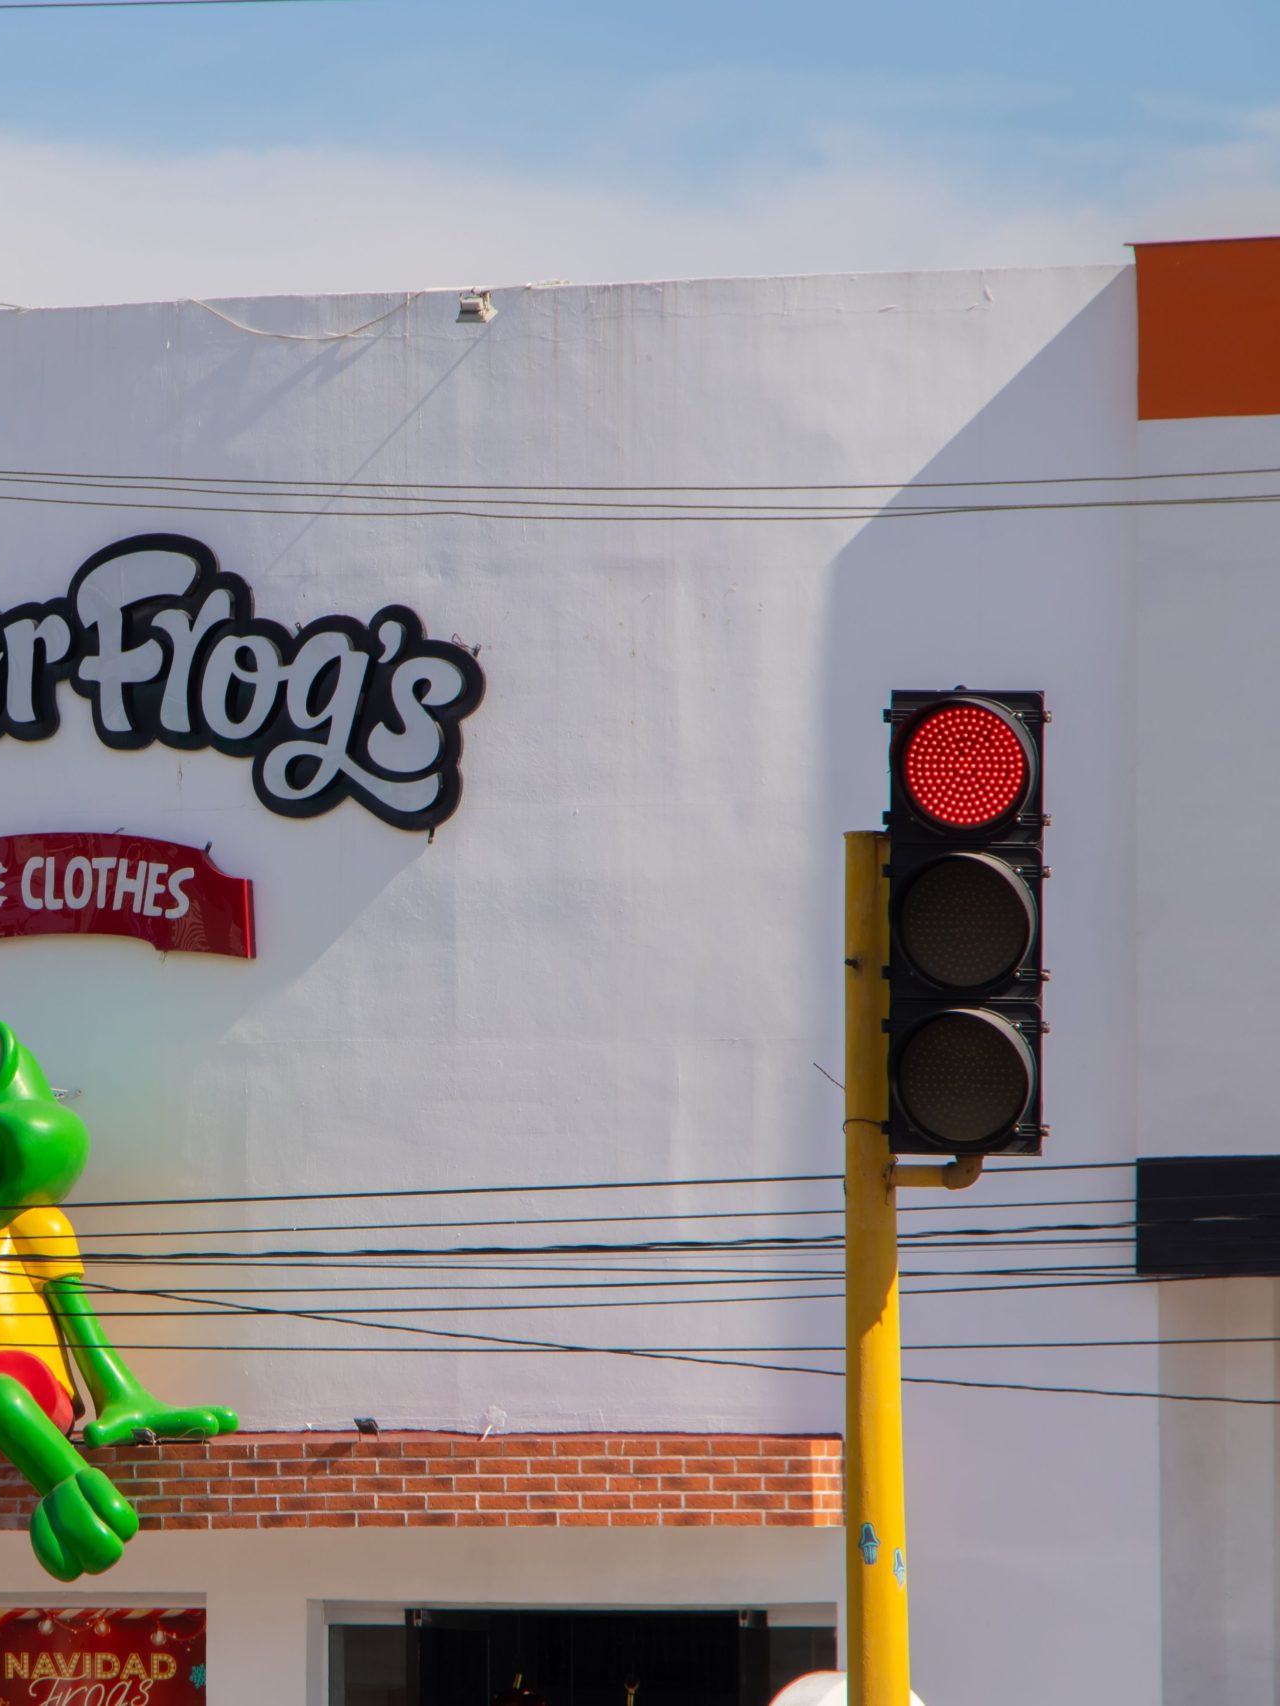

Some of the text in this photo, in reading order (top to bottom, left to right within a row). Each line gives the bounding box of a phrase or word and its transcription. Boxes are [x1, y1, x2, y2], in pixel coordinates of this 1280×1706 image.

[76, 549, 462, 813] Frog's
[21, 856, 196, 919] CLOTHES
[4, 1652, 178, 1680] NAVIDAD
